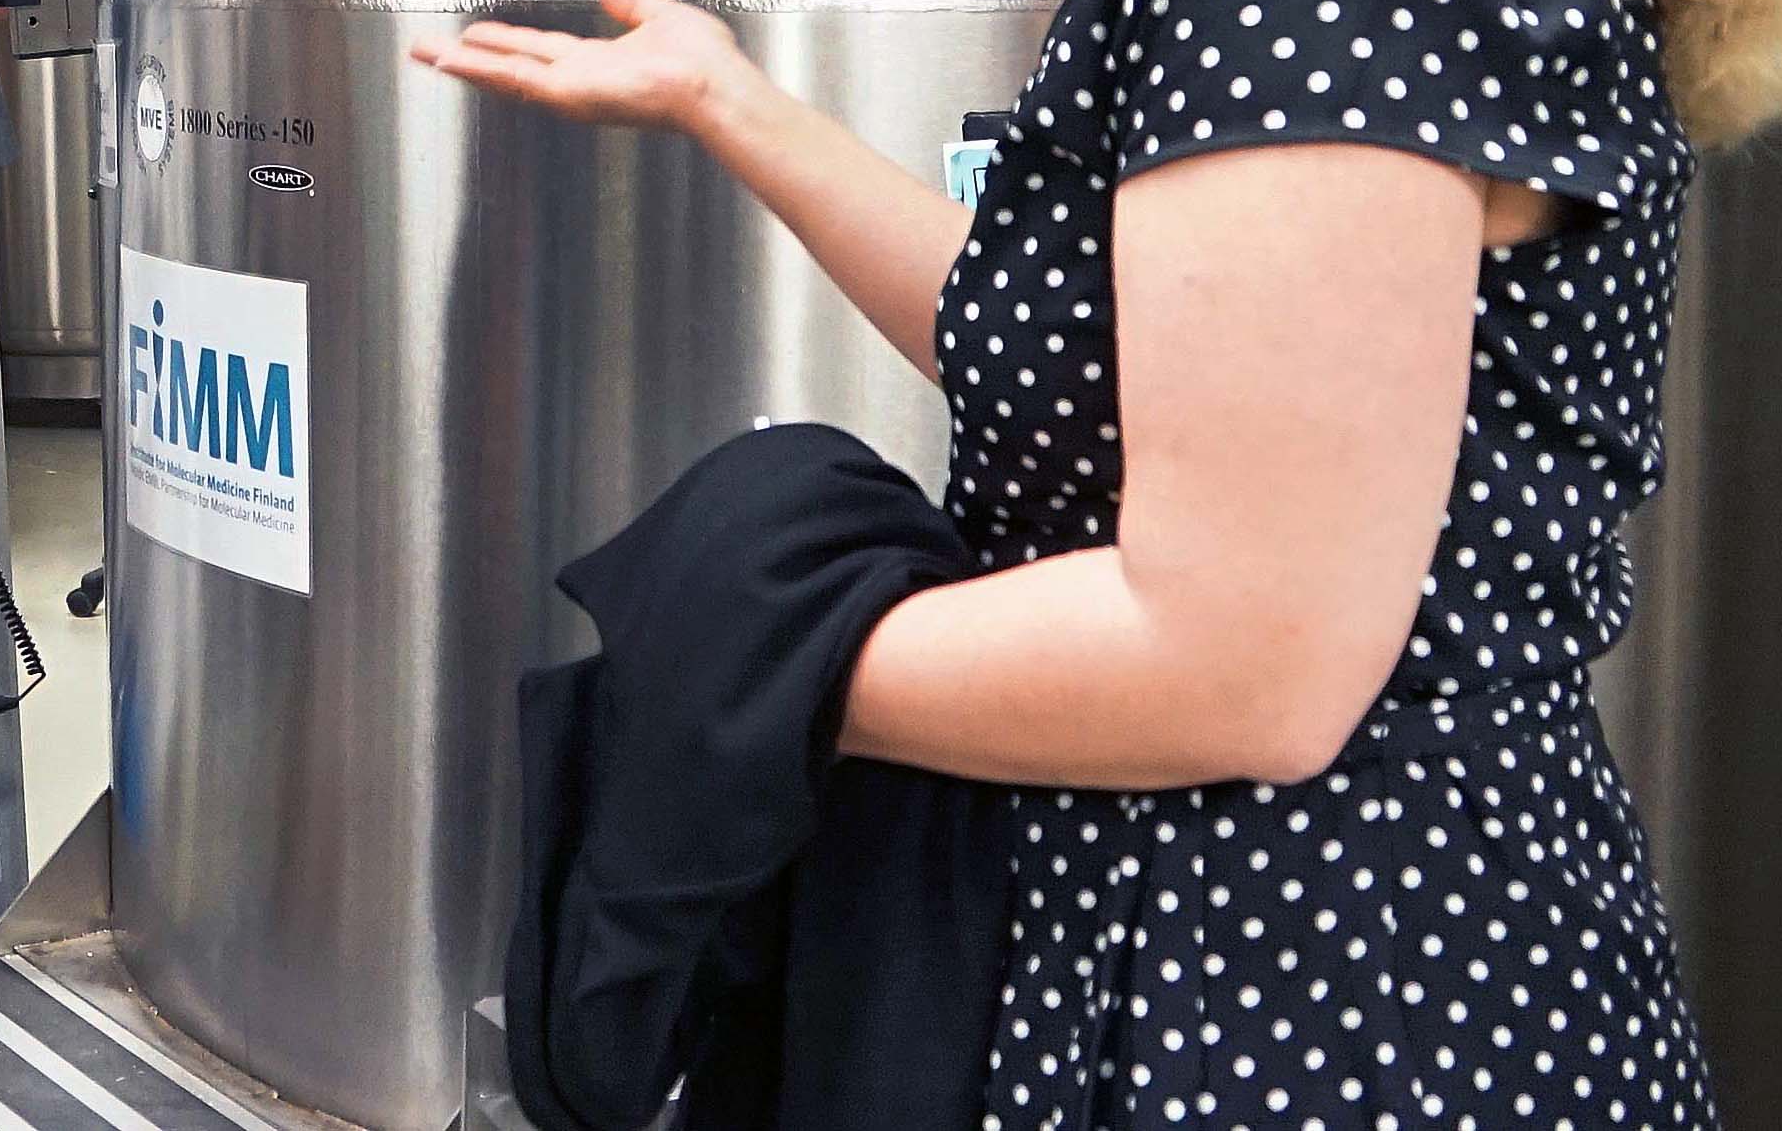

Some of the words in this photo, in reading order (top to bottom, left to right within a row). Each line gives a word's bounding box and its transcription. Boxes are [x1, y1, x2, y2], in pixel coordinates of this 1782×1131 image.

[139, 106, 163, 130] MVE
[180, 108, 212, 136] 1800
[216, 111, 266, 142] Series
[254, 170, 306, 186] CHART
[207, 473, 251, 502] Medicine
[252, 487, 295, 512] Finland
[210, 496, 251, 522] Molecular
[252, 510, 295, 533] Medicine
